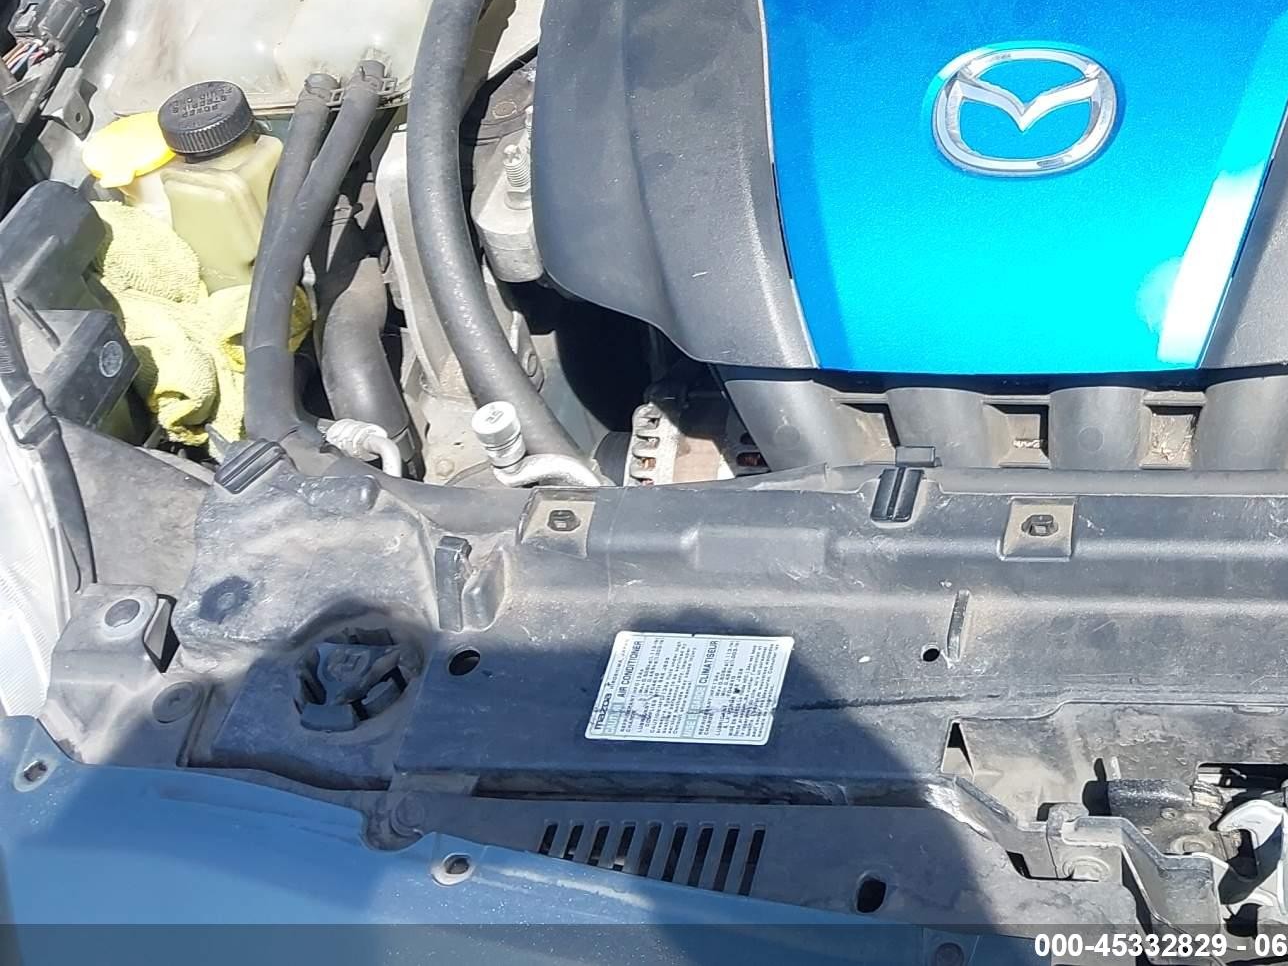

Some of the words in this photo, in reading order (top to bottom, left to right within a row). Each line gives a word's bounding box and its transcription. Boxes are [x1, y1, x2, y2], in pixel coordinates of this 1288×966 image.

[621, 640, 642, 684] CONDITIONER
[699, 640, 718, 683] CLIMATISEUR
[594, 692, 612, 729] mazda
[617, 686, 628, 697] AIR
